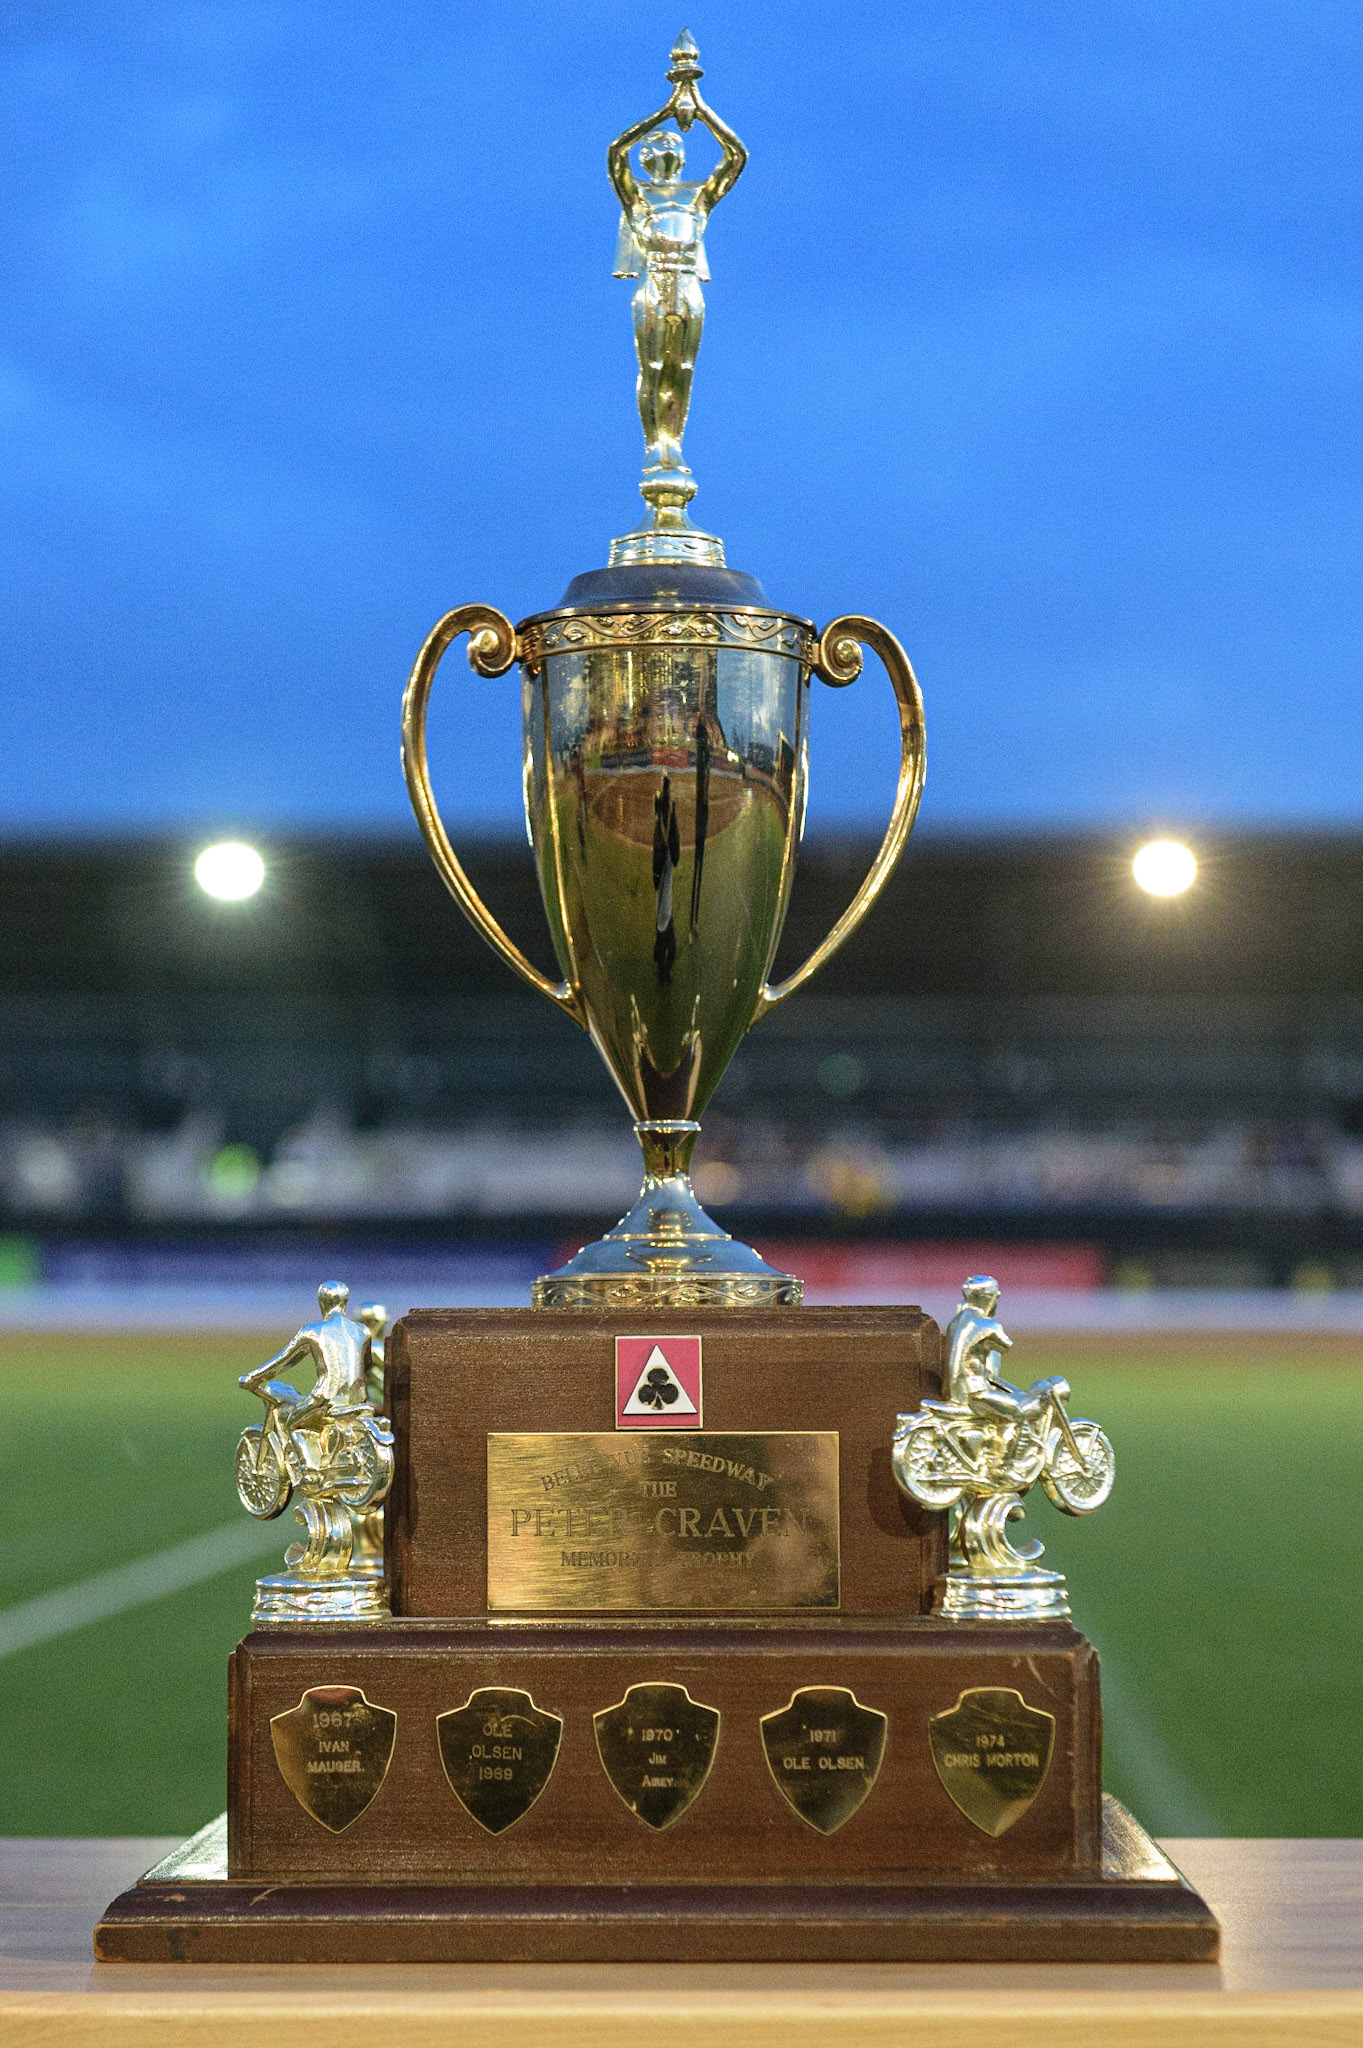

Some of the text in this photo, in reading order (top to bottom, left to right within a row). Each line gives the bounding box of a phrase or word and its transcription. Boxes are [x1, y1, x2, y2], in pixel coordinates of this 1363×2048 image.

[662, 1448, 774, 1491] SPEEDWAY
[639, 1481, 677, 1498] THE
[655, 1506, 809, 1538] CRAVEN
[561, 1551, 667, 1568] MEMOR
[313, 1711, 354, 1729] 1967
[483, 1722, 513, 1738] OLE
[642, 1728, 673, 1742] 1970
[810, 1730, 837, 1743] 1971
[319, 1741, 350, 1753] IVAN
[472, 1744, 523, 1760] OLSEN
[783, 1756, 864, 1770] OLE OLSEN
[944, 1752, 1040, 1768] CHRIS MORTON
[479, 1766, 513, 1780] 1969
